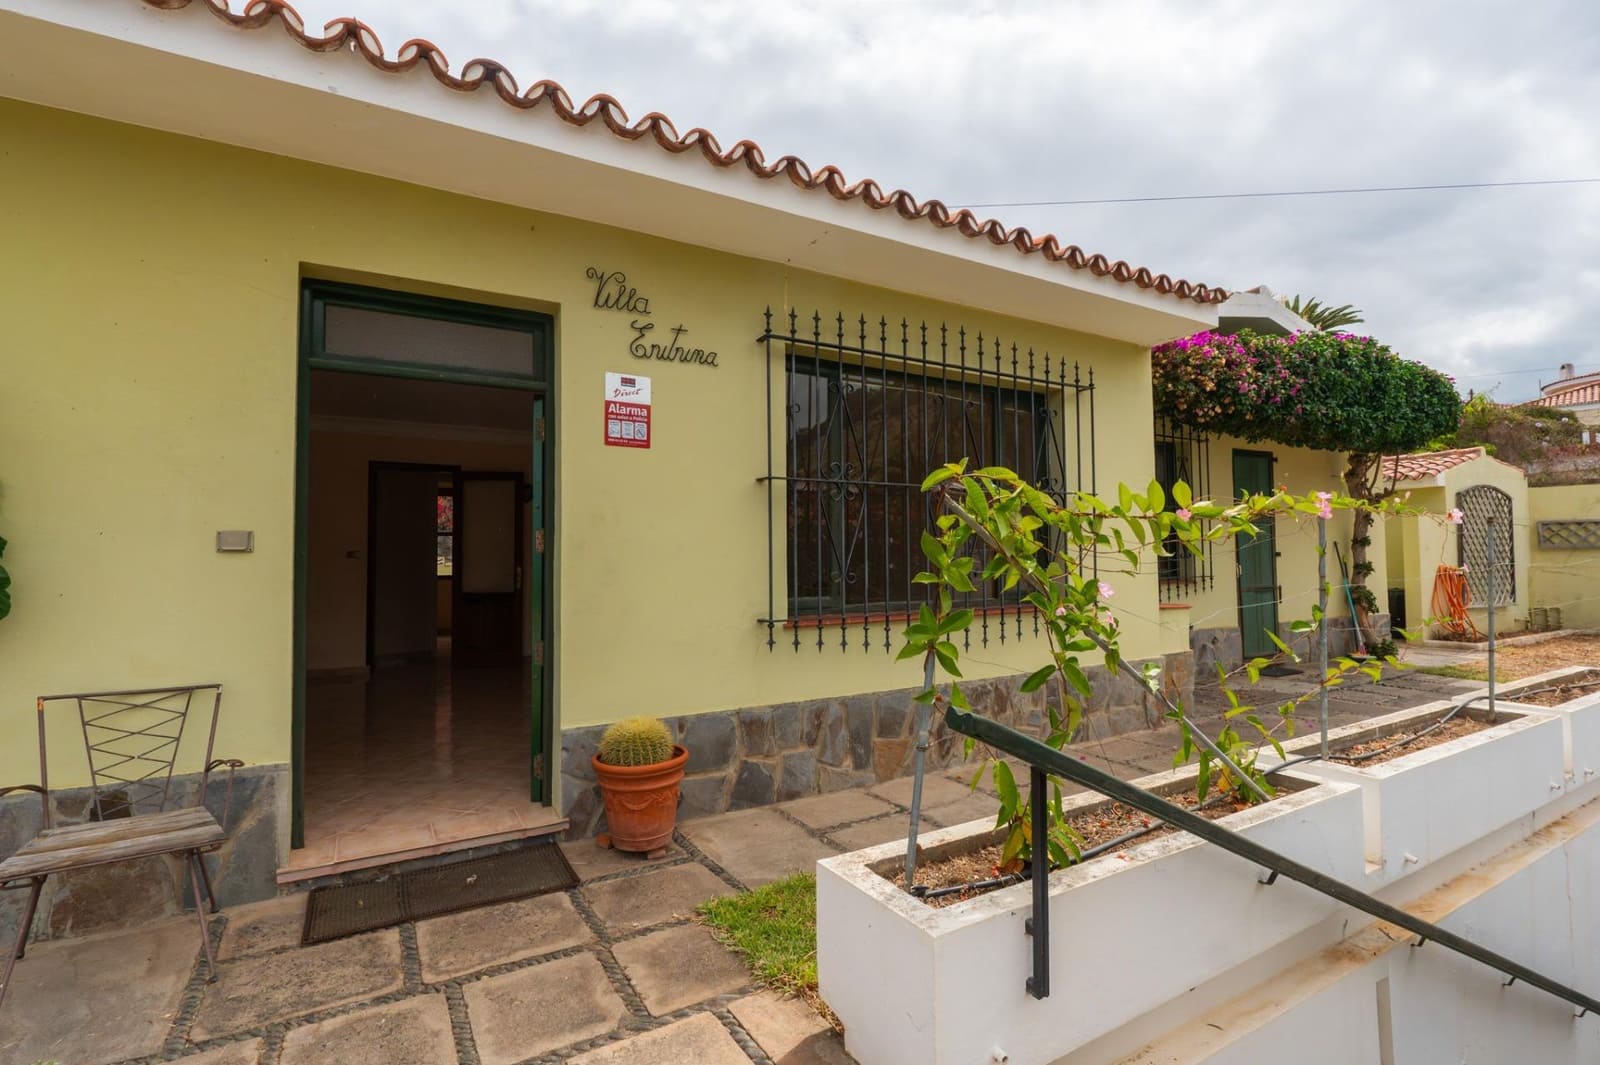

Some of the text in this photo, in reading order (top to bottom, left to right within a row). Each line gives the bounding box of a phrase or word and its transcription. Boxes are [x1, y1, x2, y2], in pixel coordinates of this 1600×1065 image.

[586, 267, 651, 314] Villa
[613, 388, 643, 398] Direct
[608, 403, 647, 417] Alarma
